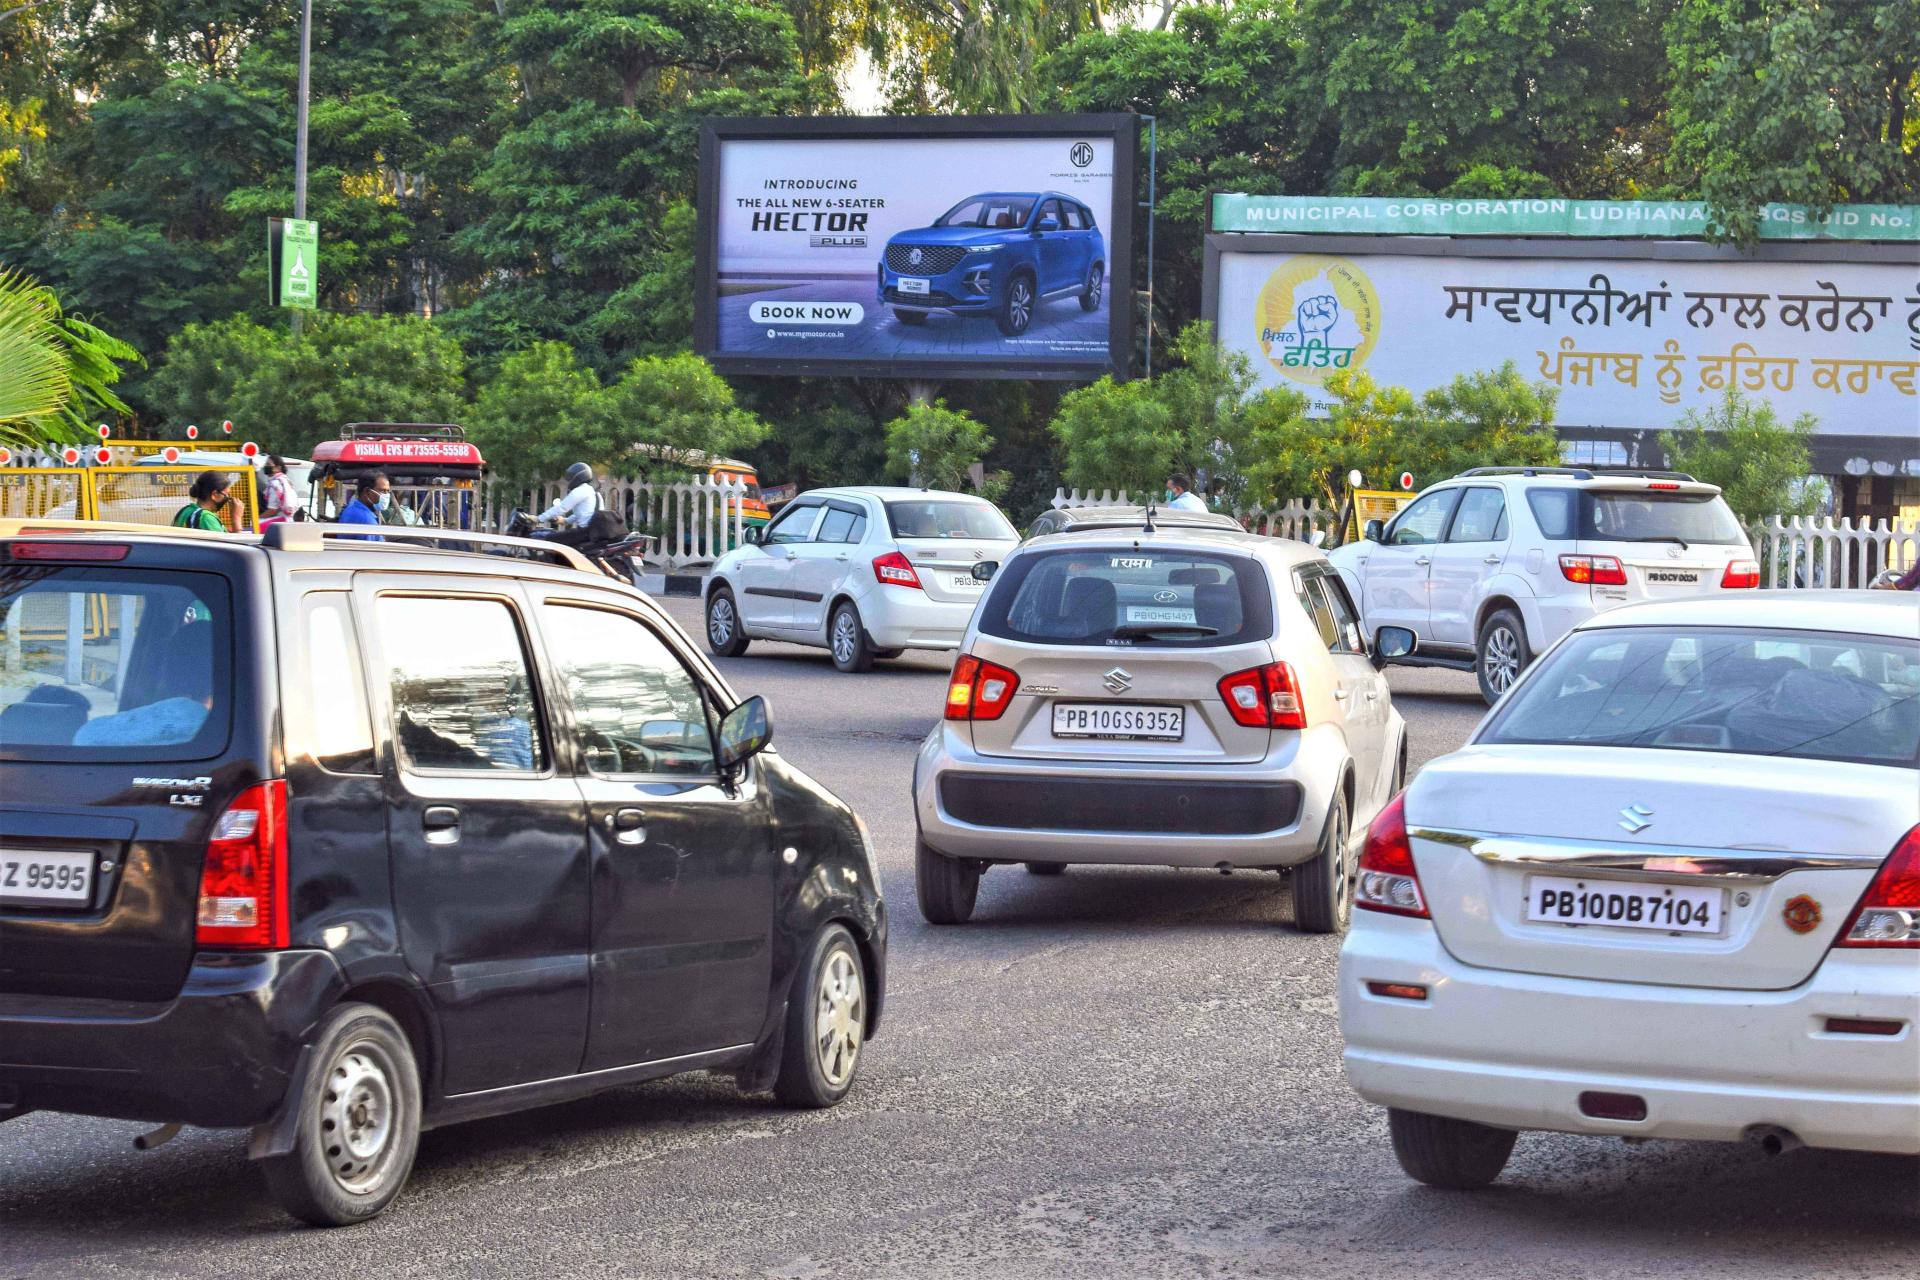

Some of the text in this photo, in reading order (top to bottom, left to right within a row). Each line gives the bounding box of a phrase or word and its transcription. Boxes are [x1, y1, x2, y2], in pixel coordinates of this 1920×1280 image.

[764, 180, 858, 190] INTRODUCING
[737, 199, 885, 208] THE ALL NEW 6-SEATER
[1246, 205, 1377, 221] MUNICIPAL
[1386, 200, 1566, 218] CORPORATION
[1574, 207, 1706, 220] LUDHIANA
[1870, 213, 1912, 227] No.
[751, 212, 868, 232] HECTOR
[821, 238, 865, 246] PLUS
[761, 307, 852, 319] BOOK NOW
[1443, 274, 1673, 328] ਸਾਵਧਾਨੀਆਂ
[1683, 291, 1770, 329] ਨਾਲ
[1778, 280, 1893, 332] ਕਰੋਨਾ
[1536, 336, 1643, 388] ਪੰਜਾਬ
[1654, 339, 1686, 404] ਨੂੰ
[355, 444, 384, 456] VISHAL
[386, 445, 402, 456] EVS
[157, 475, 187, 484] POLICE
[1067, 704, 1179, 731] PB10GS6352
[0, 861, 85, 891] Z 9595
[1540, 889, 1710, 927] PB10DB7104
